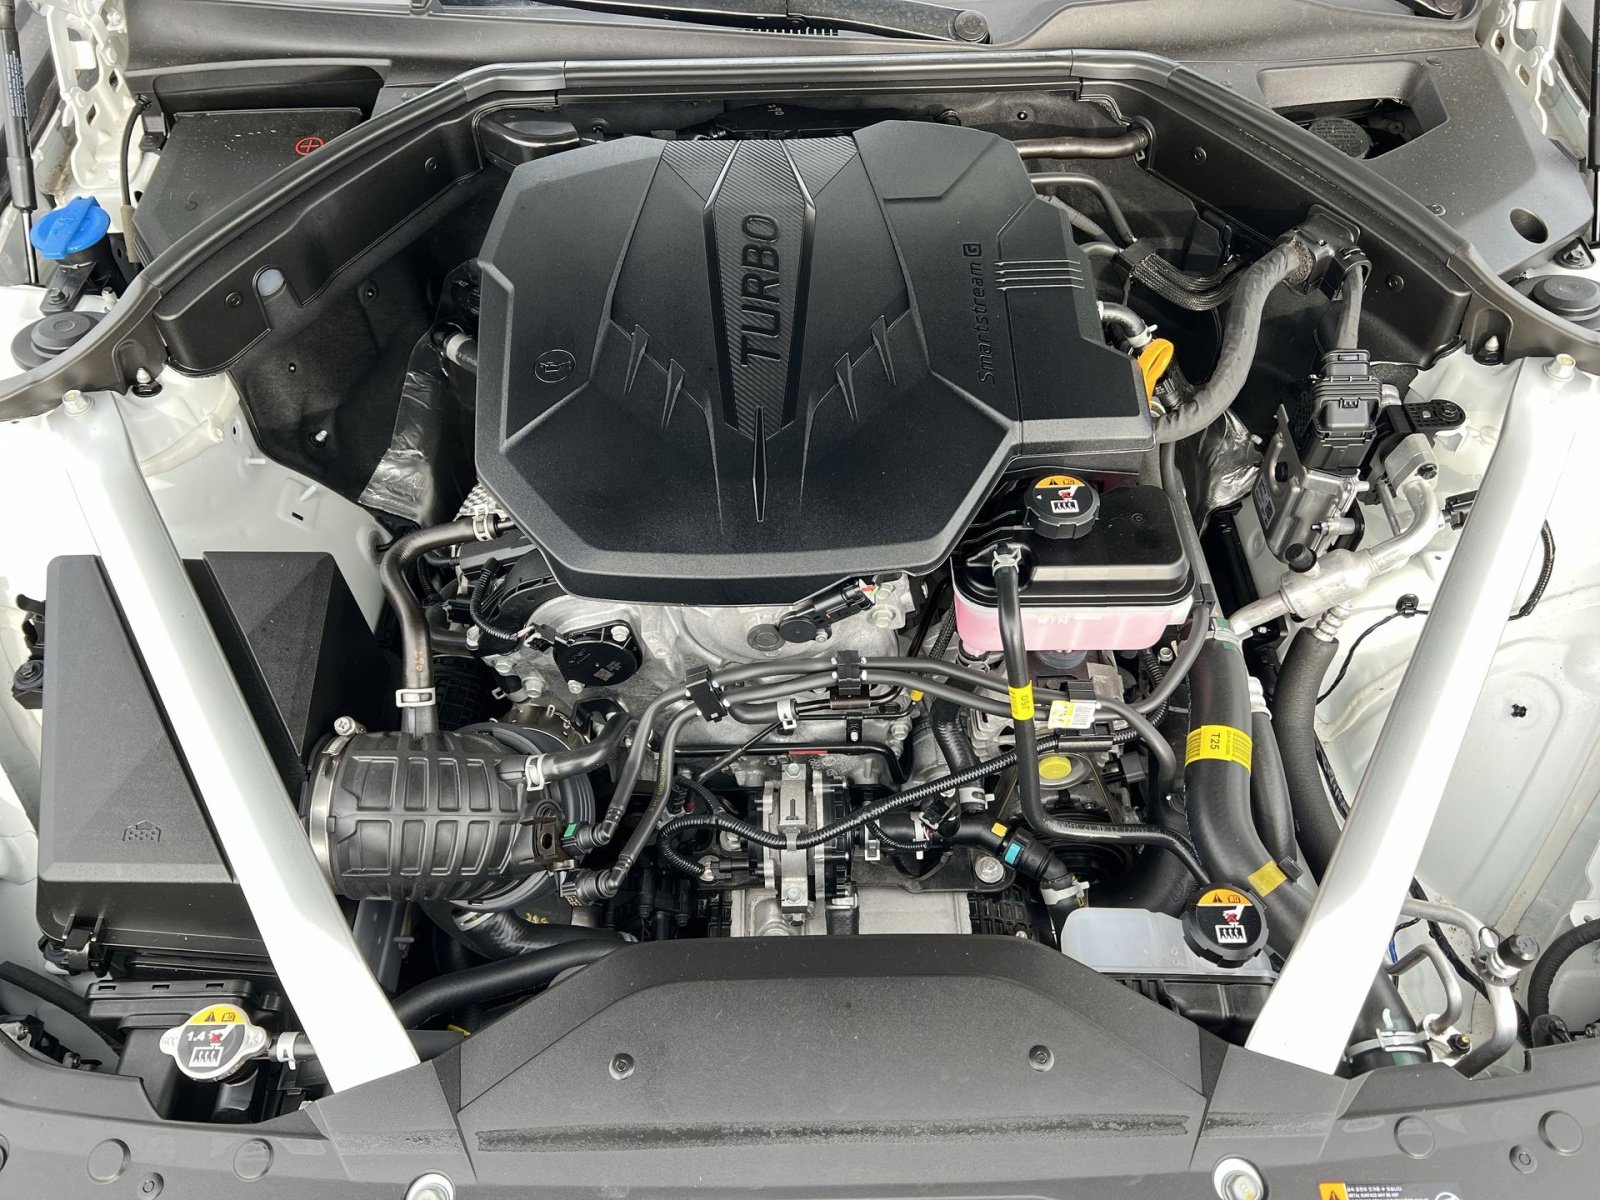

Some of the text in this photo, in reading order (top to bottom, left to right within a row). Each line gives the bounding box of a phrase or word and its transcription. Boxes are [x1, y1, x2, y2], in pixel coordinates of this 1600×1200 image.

[740, 213, 781, 368] TURBO
[969, 262, 996, 386] Smartstream
[1036, 615, 1069, 625] MIN
[1210, 732, 1221, 750] T25
[187, 1031, 206, 1042] 1.4
